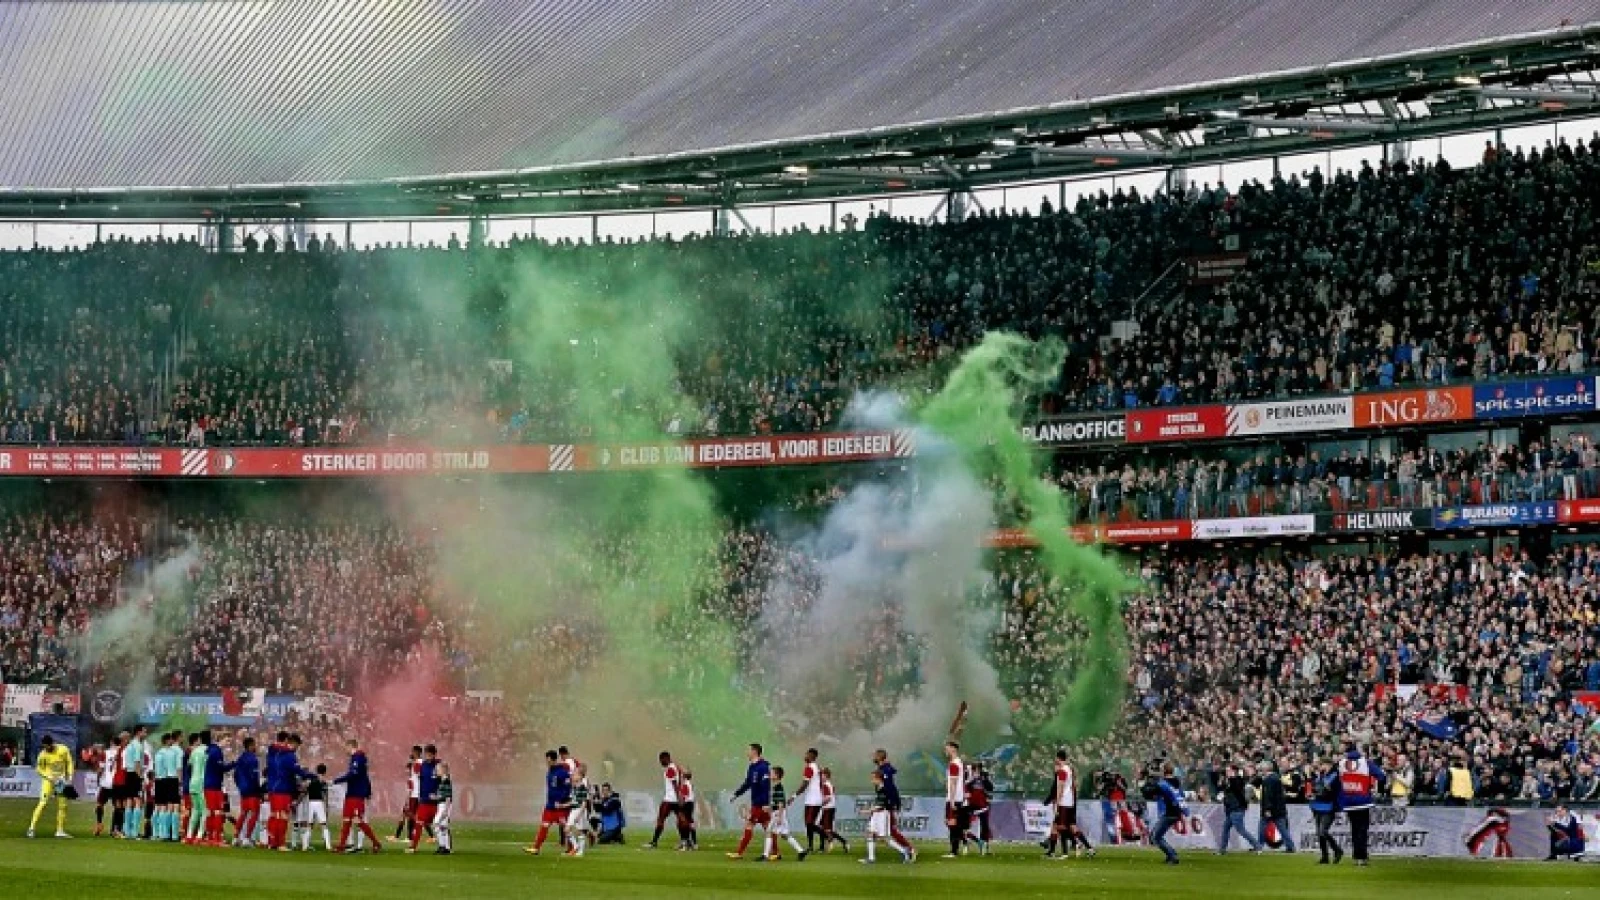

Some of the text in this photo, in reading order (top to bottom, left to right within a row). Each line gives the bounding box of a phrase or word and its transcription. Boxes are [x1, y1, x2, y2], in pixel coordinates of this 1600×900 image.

[1266, 403, 1347, 420] PEINEMANN
[1369, 397, 1419, 424] ING
[1475, 392, 1594, 412] SPIE SPIE SPIE
[620, 435, 891, 465] CLUB VAN IEDEREEN, VOOR IEDEREEN
[302, 450, 489, 471] STERKER DOOR STRIJD
[1347, 510, 1413, 530] HELMINK
